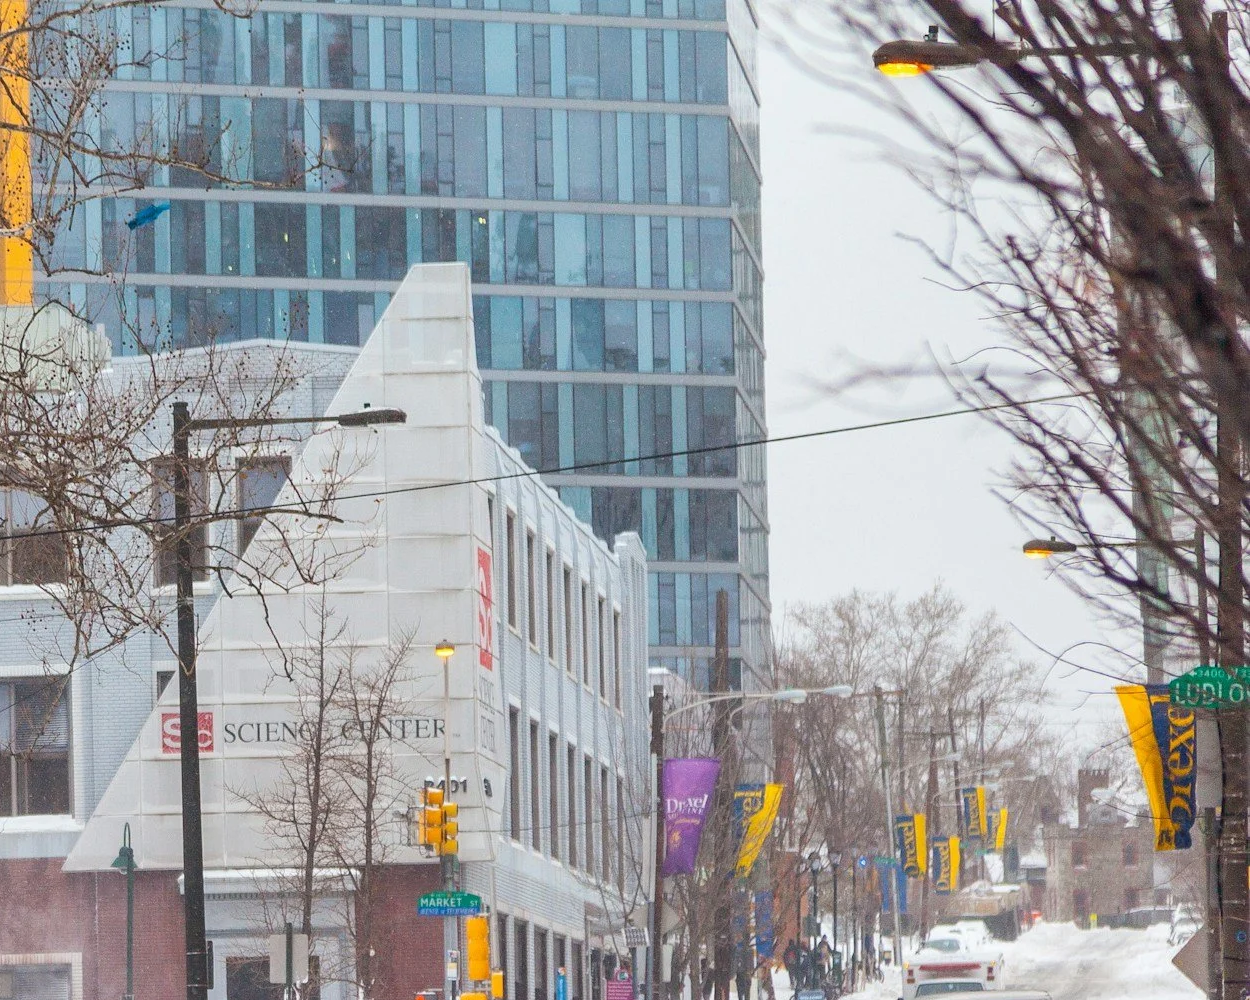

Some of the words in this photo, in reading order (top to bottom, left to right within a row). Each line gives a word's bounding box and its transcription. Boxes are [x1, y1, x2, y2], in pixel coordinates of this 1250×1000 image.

[224, 721, 330, 743] SCIENCE
[341, 719, 446, 740] CENTER
[665, 793, 709, 813] Drxel
[421, 897, 462, 908] MARKET
